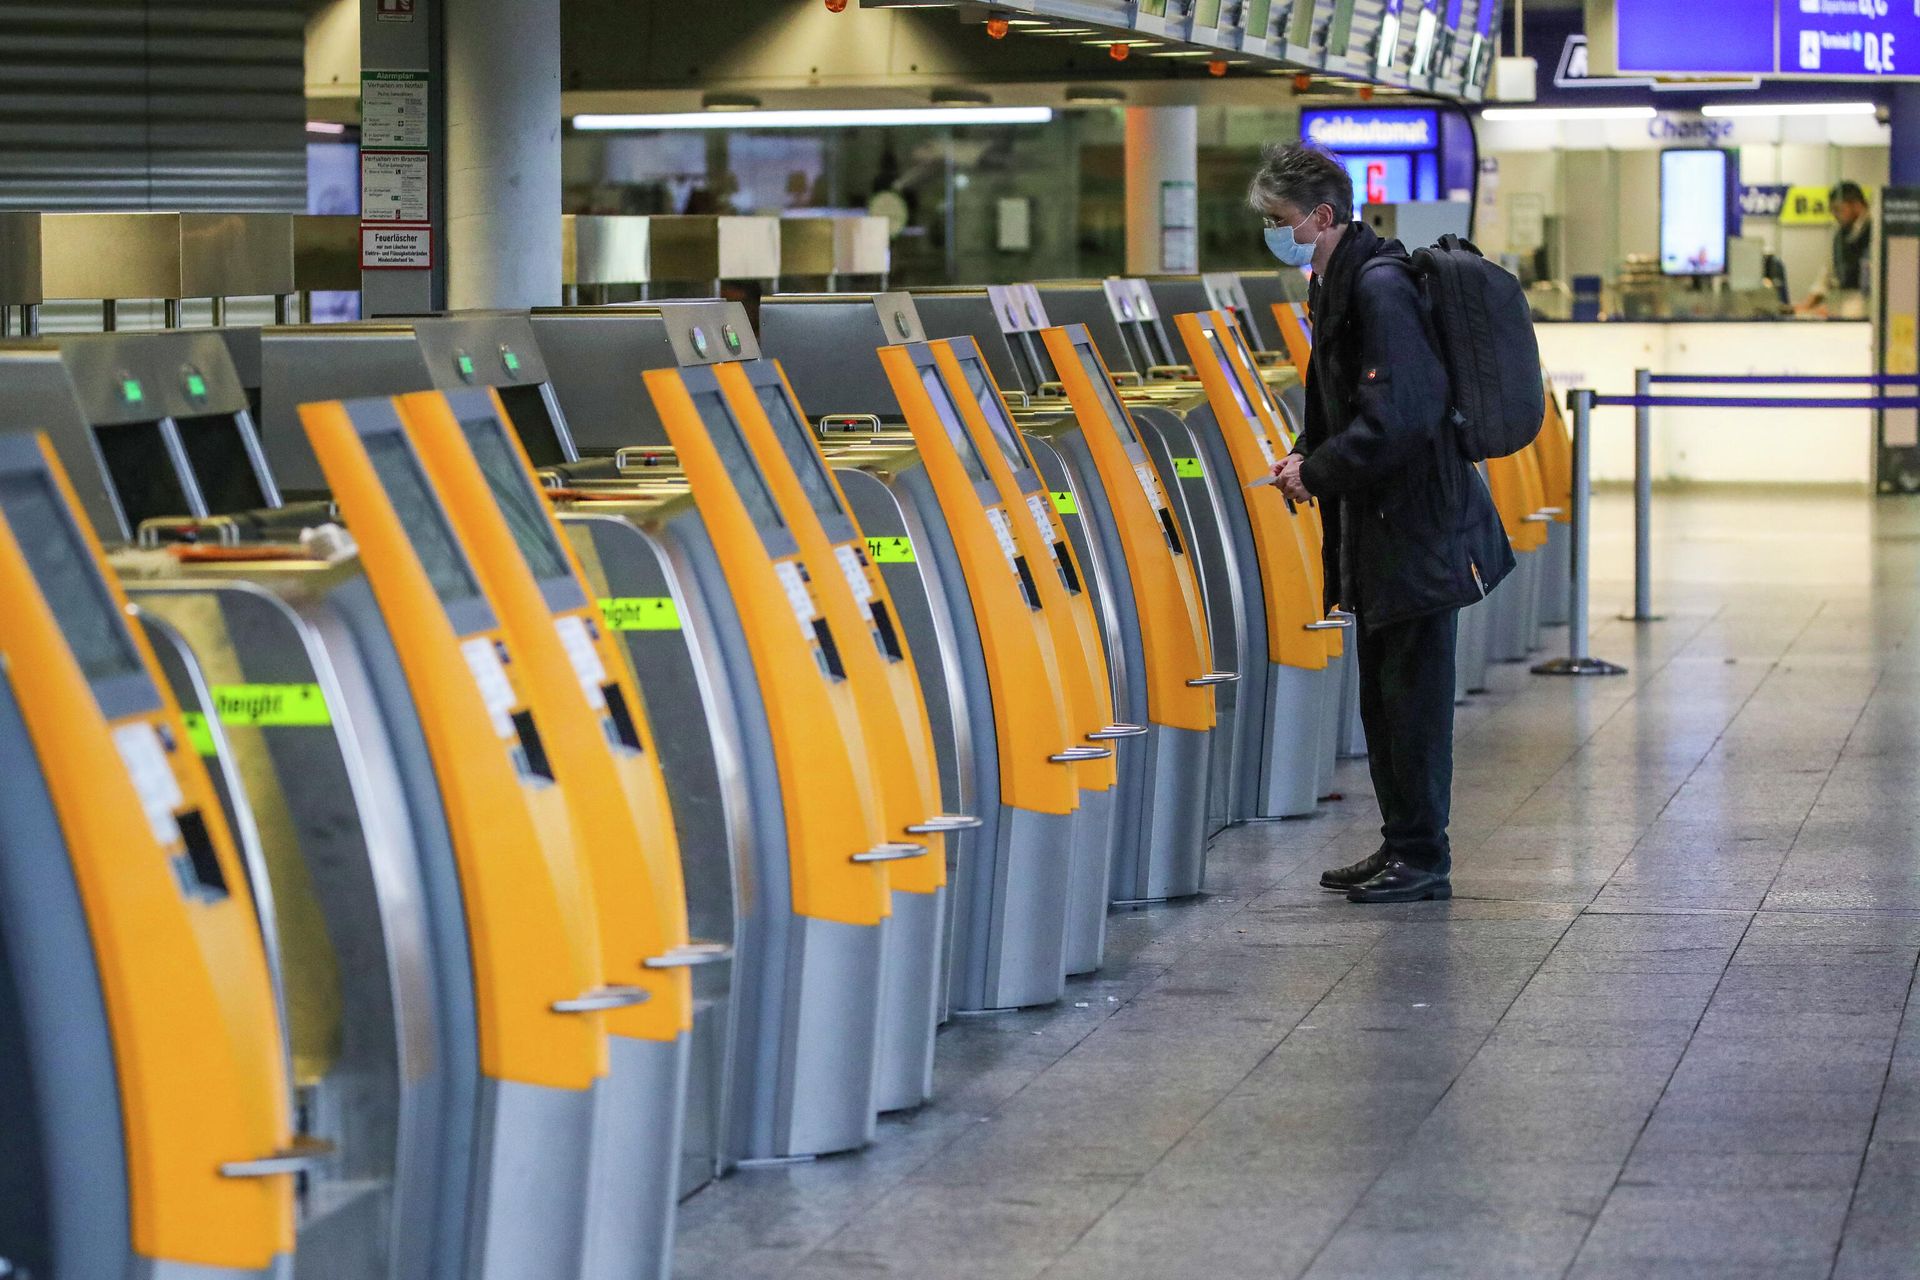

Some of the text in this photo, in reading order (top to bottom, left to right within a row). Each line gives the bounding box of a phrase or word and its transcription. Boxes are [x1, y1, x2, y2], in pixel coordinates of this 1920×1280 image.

[376, 72, 415, 80] Alarmplan
[1308, 116, 1428, 145] Geldautomat
[1649, 116, 1734, 147] Change
[375, 233, 418, 242] Feuerlöscher
[219, 694, 282, 720] height
